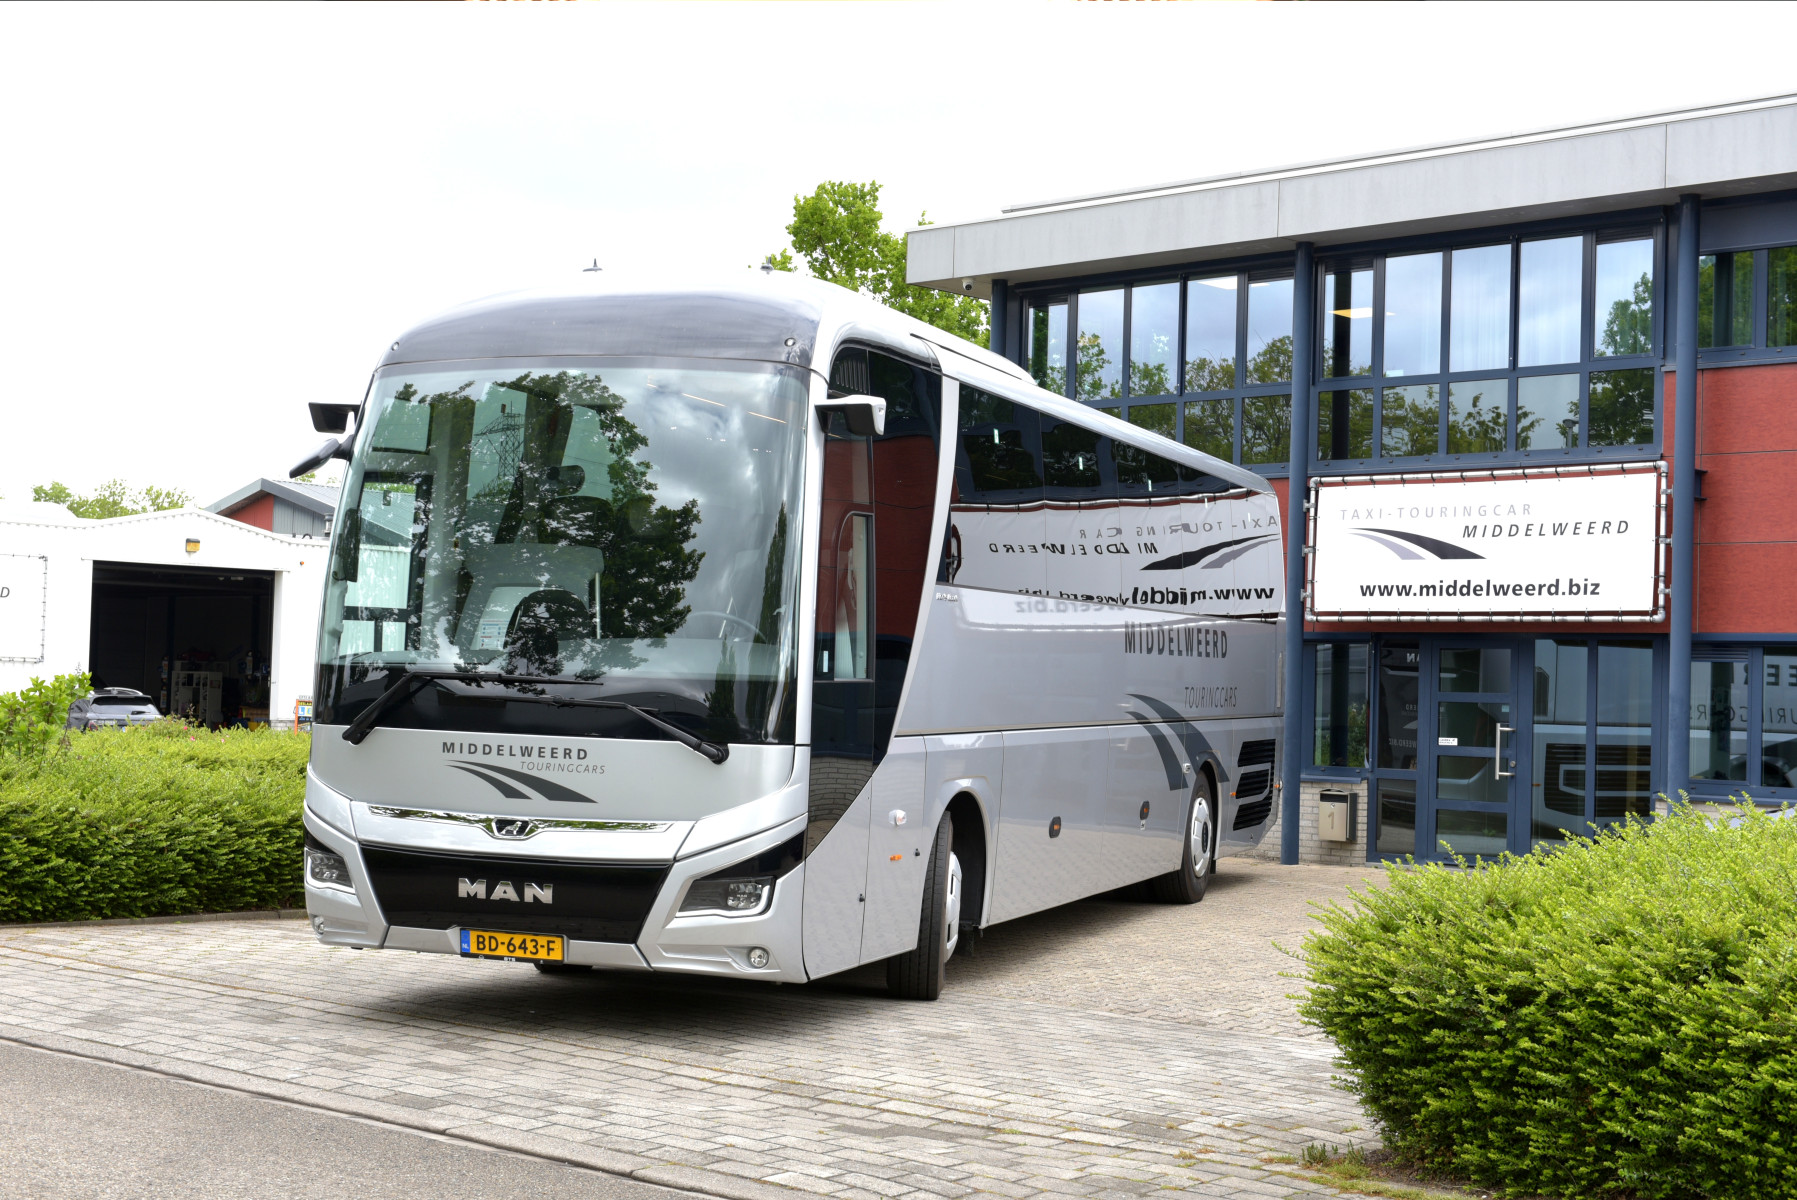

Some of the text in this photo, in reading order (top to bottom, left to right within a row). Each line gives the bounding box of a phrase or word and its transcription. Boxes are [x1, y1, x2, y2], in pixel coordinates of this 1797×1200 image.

[1340, 503, 1532, 521] TAXI-TOURINGCAR
[1463, 520, 1629, 539] MIDDELWEERD
[1359, 578, 1601, 597] www.middelweerd.biz
[1124, 621, 1229, 659] MIDDELWEERD
[1184, 686, 1238, 709] TOURINGCARS
[441, 741, 589, 761] MIDDELWEERD
[519, 760, 606, 775] TOURINGCARS
[457, 877, 553, 904] MAN
[476, 934, 556, 957] BD-643-F
